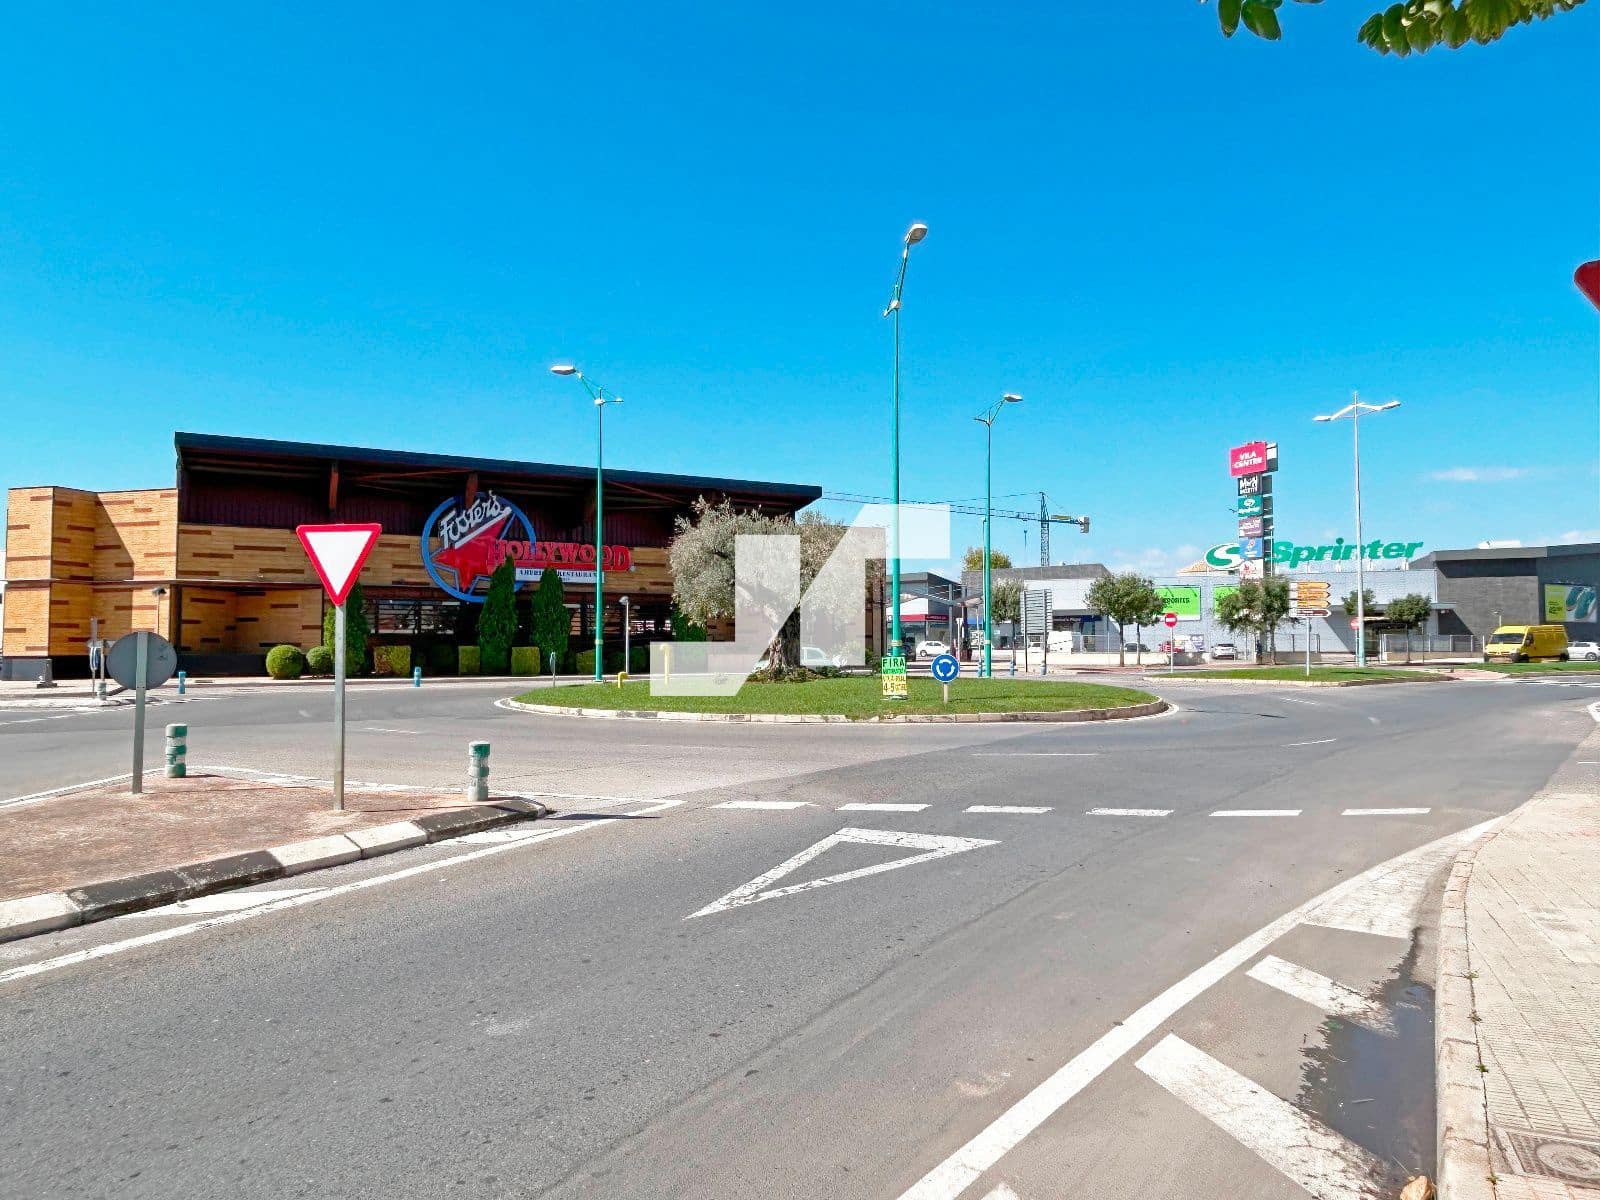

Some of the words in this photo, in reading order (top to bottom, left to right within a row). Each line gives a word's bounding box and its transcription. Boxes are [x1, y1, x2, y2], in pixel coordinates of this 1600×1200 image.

[1239, 450, 1257, 461] VILA
[487, 538, 632, 575] HOLLYWOOD
[1272, 537, 1424, 568] Sprinter
[882, 658, 905, 668] FIRA
